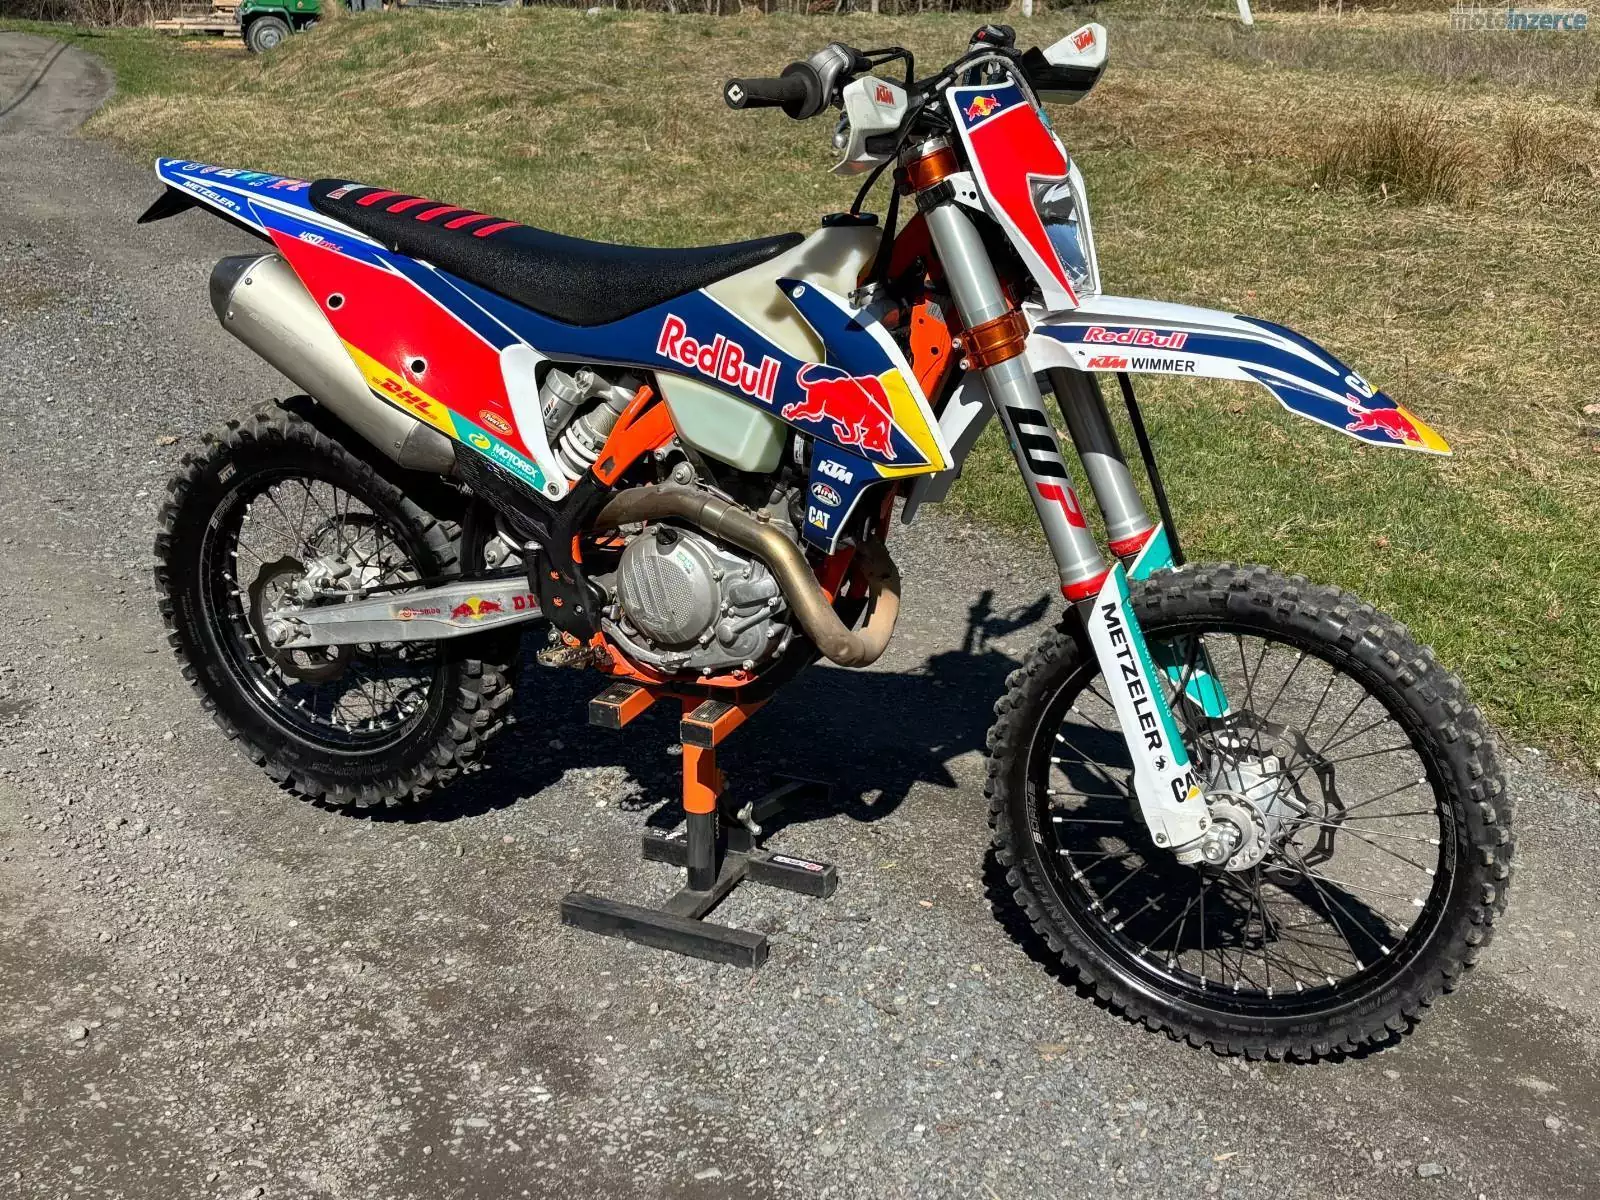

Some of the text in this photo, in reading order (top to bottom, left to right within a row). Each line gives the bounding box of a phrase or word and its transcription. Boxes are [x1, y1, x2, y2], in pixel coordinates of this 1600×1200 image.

[1073, 29, 1094, 50] KTM
[875, 84, 895, 105] KTM
[183, 181, 237, 208] METZELER
[1087, 356, 1195, 373] KTM WIMMER
[381, 378, 432, 415] DHL
[493, 443, 539, 478] MOTOREX
[817, 459, 854, 485] KTM
[813, 484, 840, 505] Airoh
[808, 505, 831, 531] CAT
[1101, 601, 1163, 751] METZELER
[1170, 767, 1200, 803] CA
